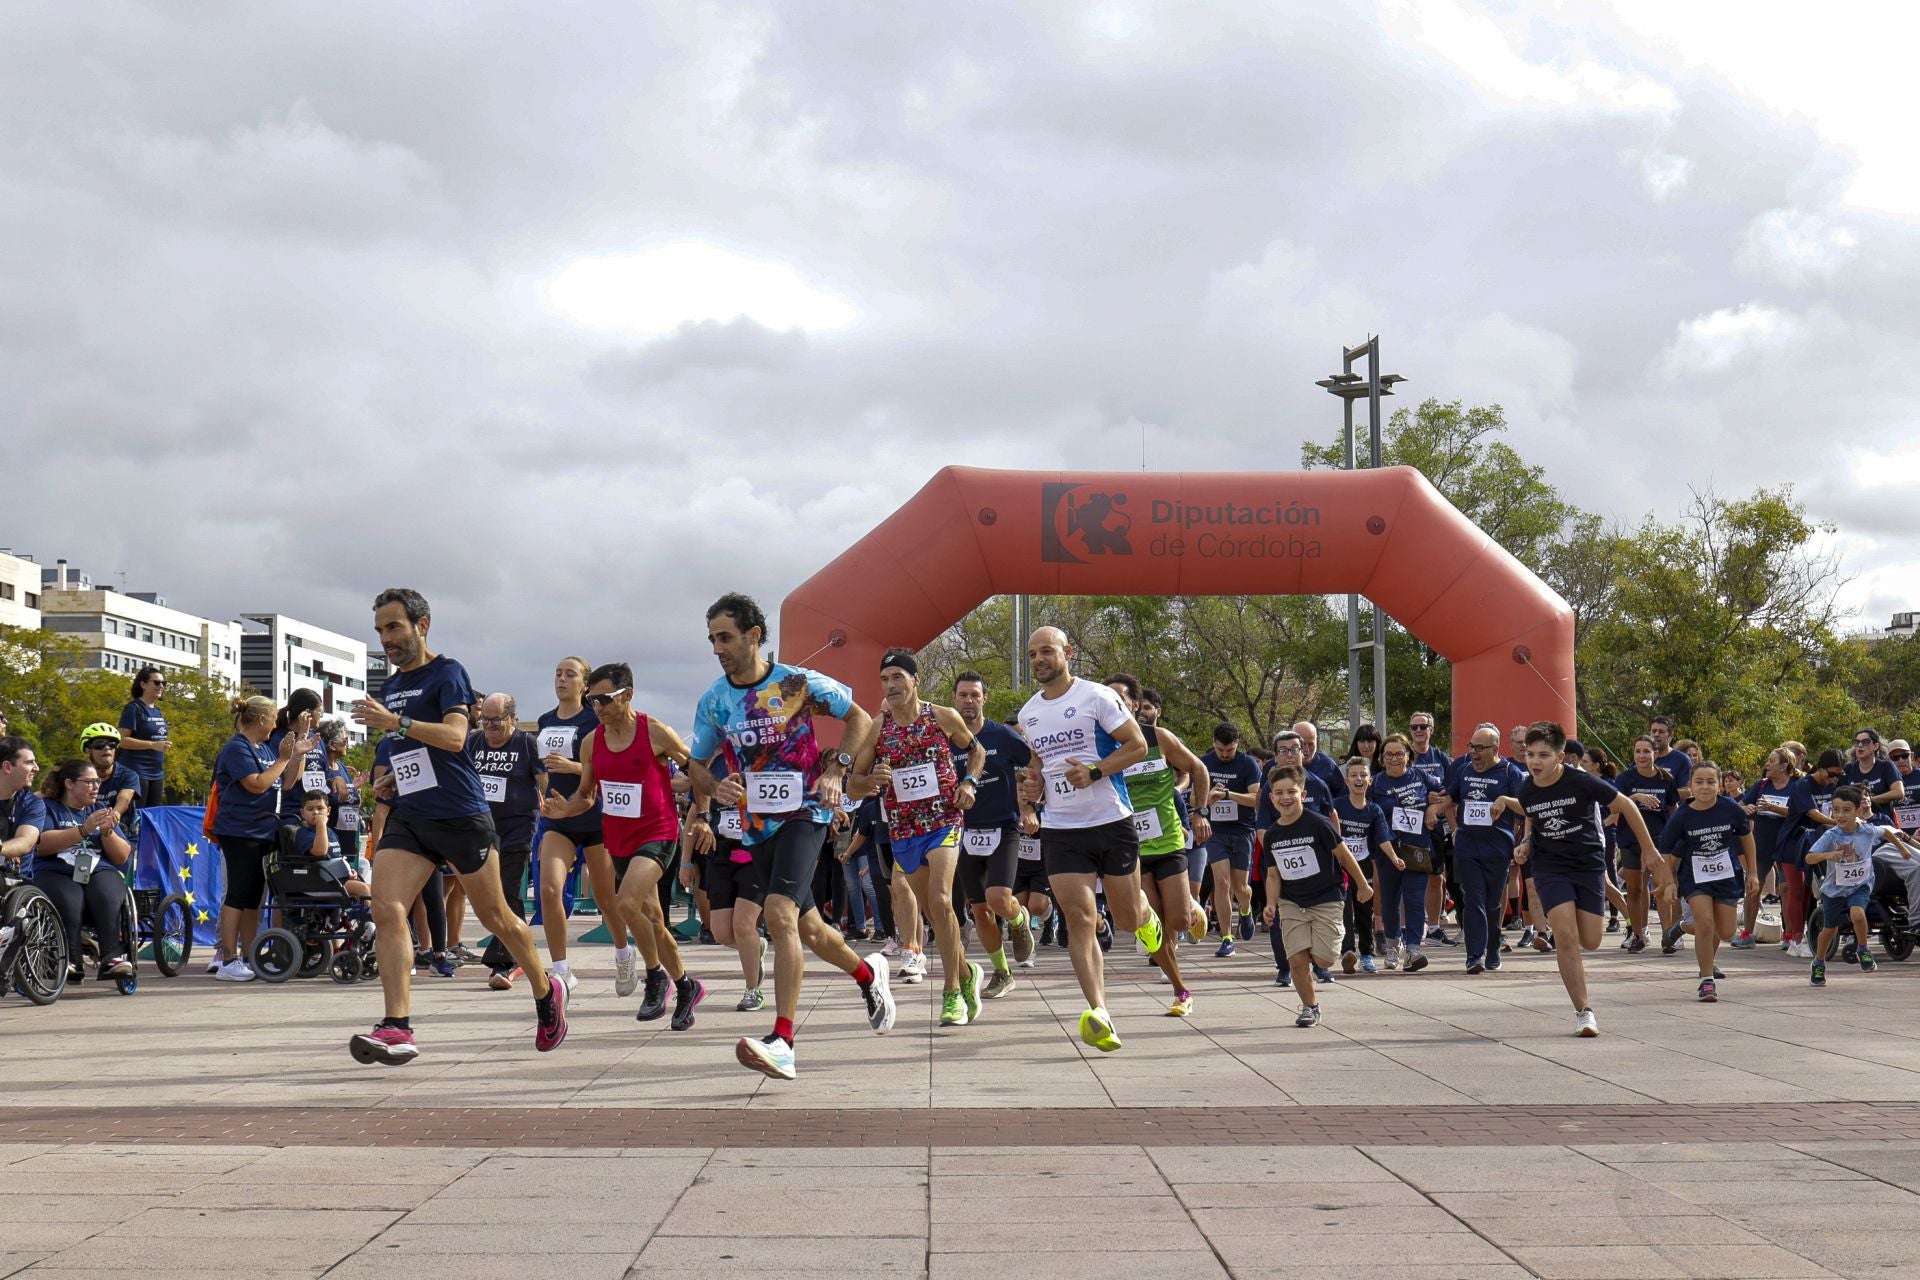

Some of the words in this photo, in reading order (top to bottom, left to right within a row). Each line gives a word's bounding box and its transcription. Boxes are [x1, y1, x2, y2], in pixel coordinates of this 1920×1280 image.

[1151, 500, 1321, 529] Diputación
[1150, 533, 1185, 557] de
[1197, 533, 1321, 558] Córdoba
[736, 716, 787, 730] CEREBRO
[759, 727, 775, 736] ES
[545, 736, 564, 748] 469
[726, 731, 757, 748] NO
[759, 734, 787, 744] GRIS
[475, 750, 485, 760] VA
[487, 751, 507, 761] POR
[510, 752, 518, 761] TI
[397, 762, 420, 781] 539
[474, 761, 513, 772] PABLO
[310, 778, 323, 787] 157
[902, 775, 927, 790] 525
[1055, 781, 1076, 794] 41
[759, 784, 789, 799] 526
[607, 792, 630, 805] 560
[1216, 806, 1231, 814] 013
[1470, 809, 1486, 817] 206
[971, 836, 992, 846] 021
[1284, 856, 1307, 869] 061
[1701, 861, 1724, 873] 456
[1844, 868, 1864, 879] 246
